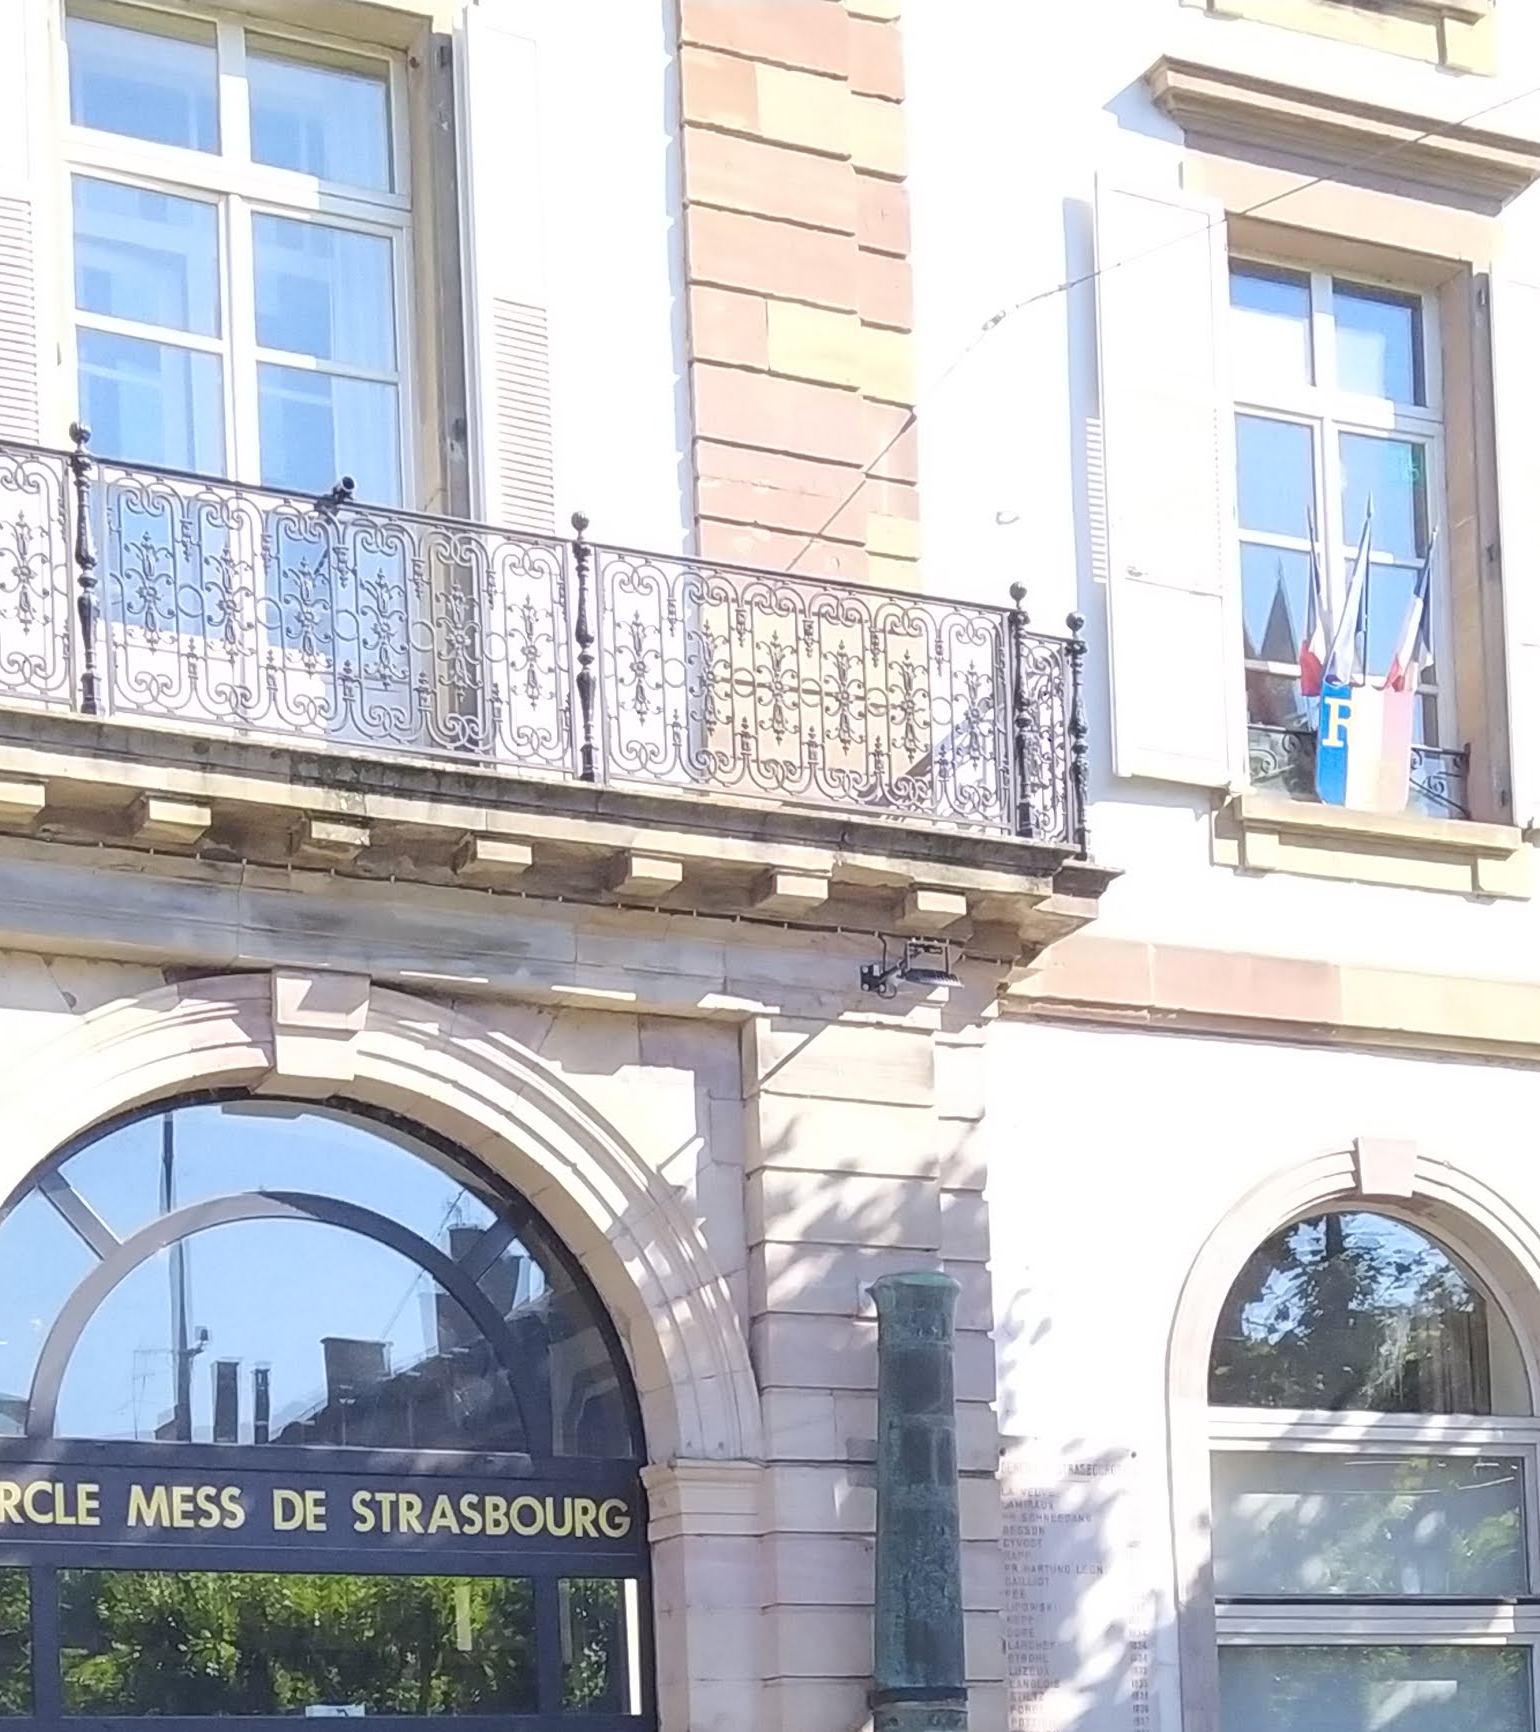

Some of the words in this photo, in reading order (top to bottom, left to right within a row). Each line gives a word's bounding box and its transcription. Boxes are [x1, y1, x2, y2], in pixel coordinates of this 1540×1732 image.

[127, 1484, 245, 1529] MESS
[273, 1488, 327, 1533] DE
[351, 1490, 631, 1540] STRASBOURG
